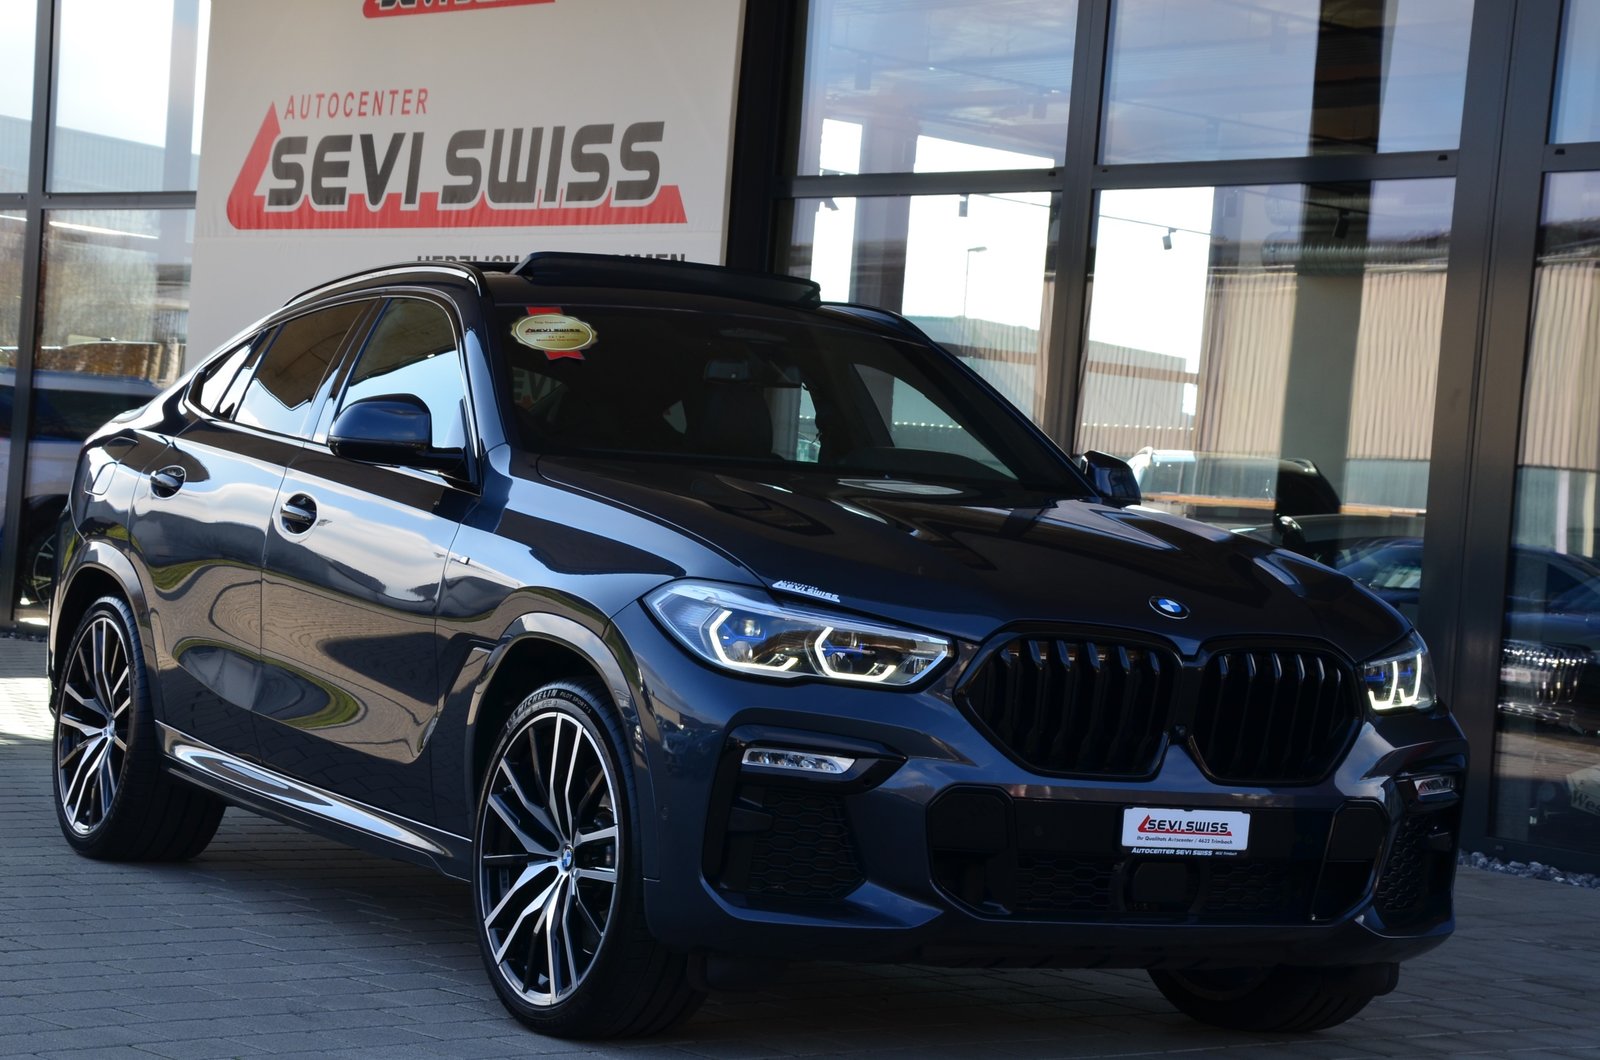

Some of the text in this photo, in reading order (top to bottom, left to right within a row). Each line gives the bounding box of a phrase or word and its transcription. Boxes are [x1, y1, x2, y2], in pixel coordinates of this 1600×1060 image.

[284, 87, 429, 120] AUTOCENTER
[267, 121, 665, 207] SEVI SWISS
[517, 689, 558, 715] MICHELIN
[1147, 819, 1229, 833] SEVI SWISS
